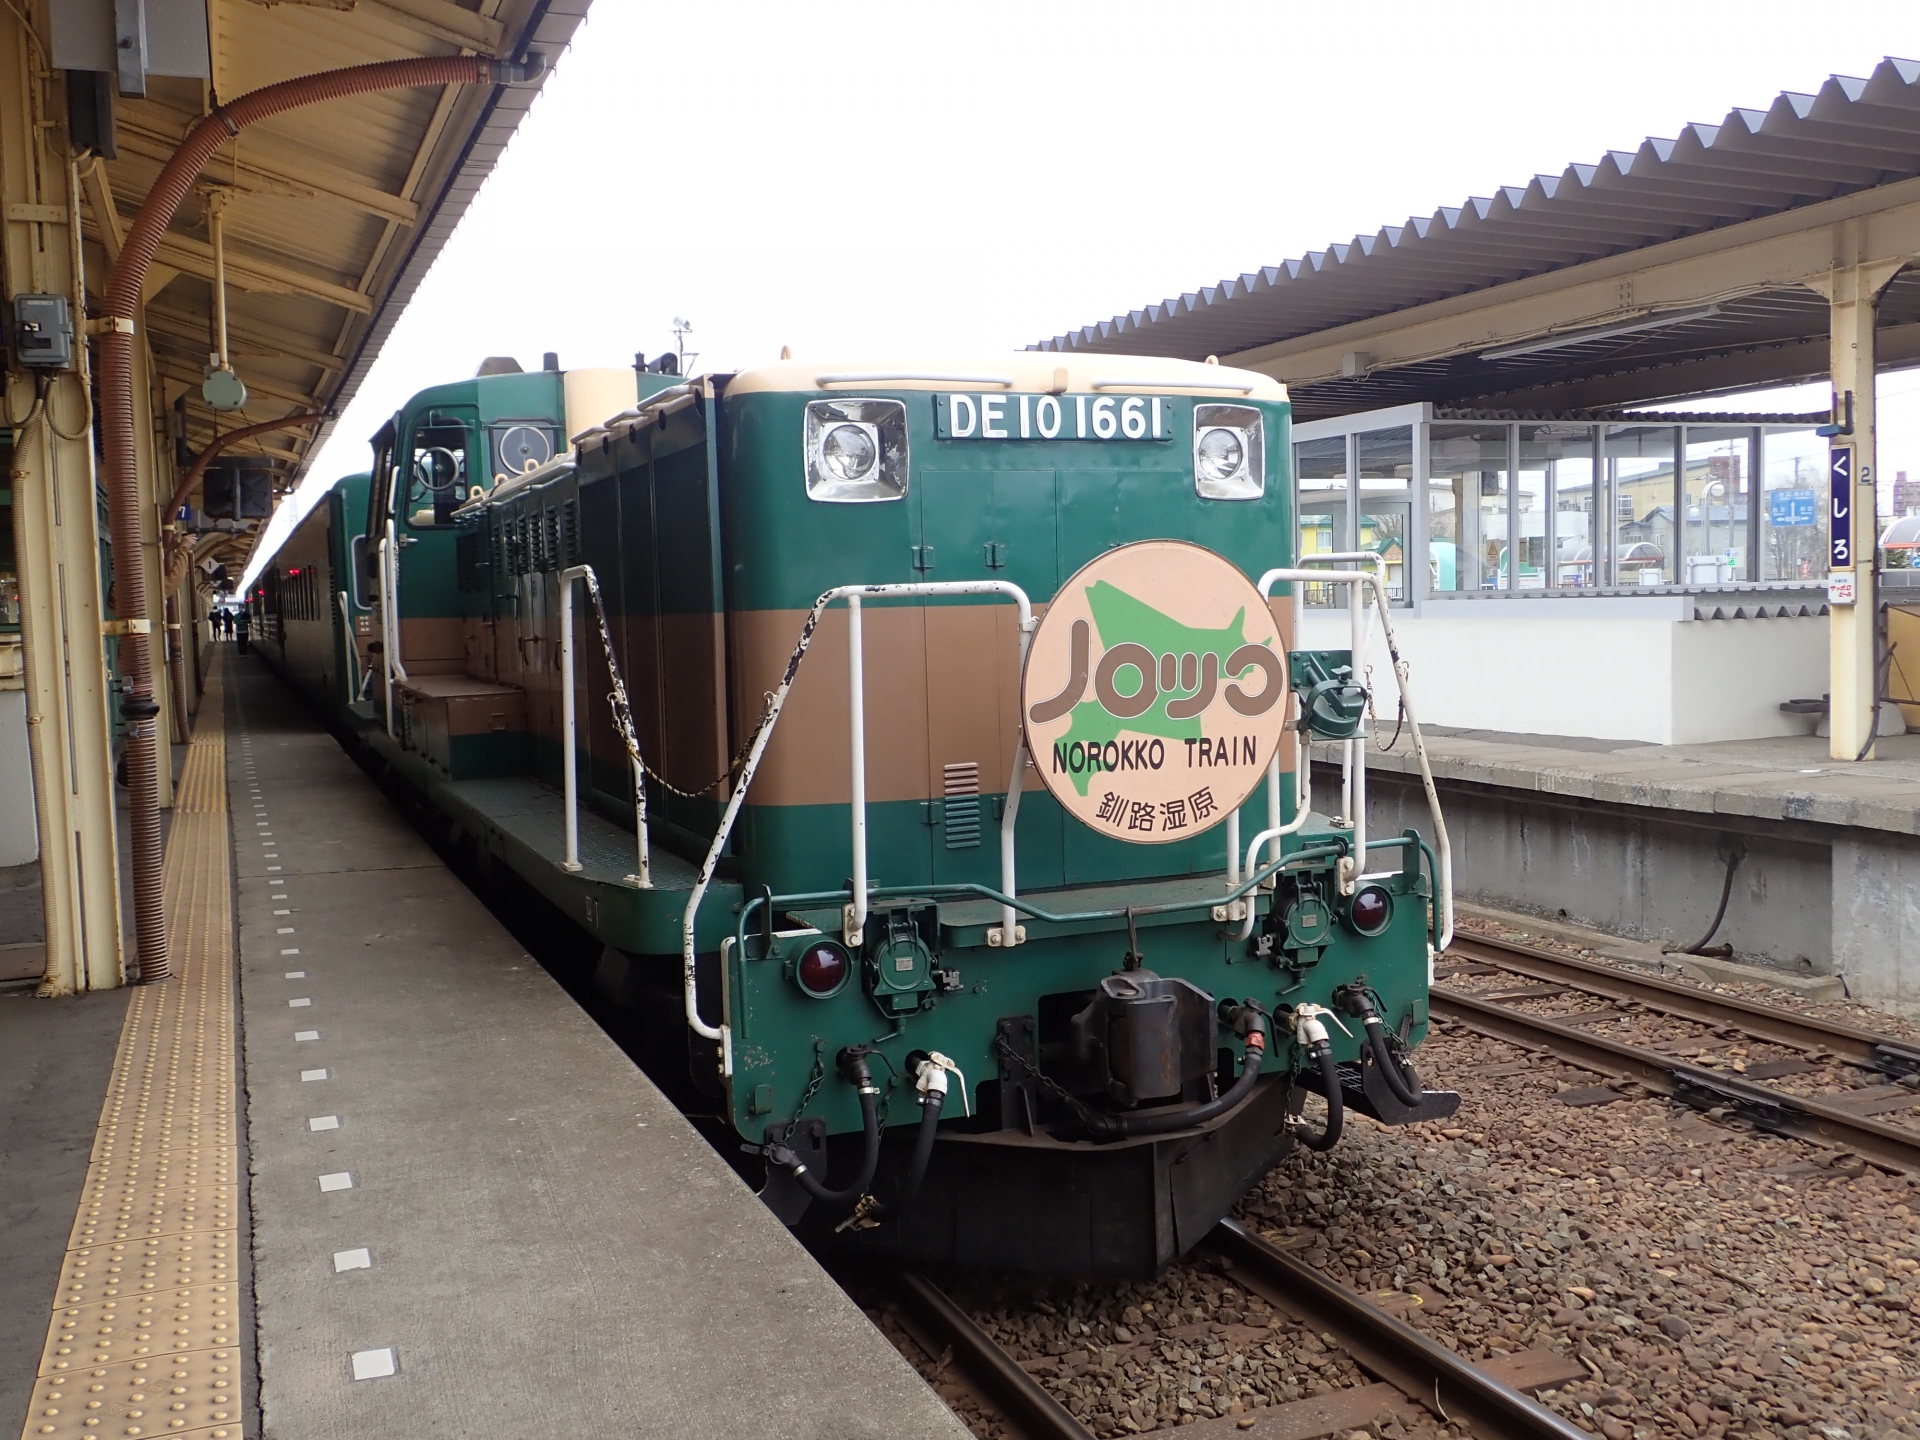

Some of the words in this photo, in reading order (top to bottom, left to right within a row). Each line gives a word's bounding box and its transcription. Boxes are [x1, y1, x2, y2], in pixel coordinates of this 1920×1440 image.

[949, 394, 1008, 438] DE
[1019, 395, 1062, 439] 10
[1075, 396, 1162, 439] 1661
[1860, 466, 1871, 483] 2
[1832, 455, 1849, 560] くしろ
[1052, 738, 1166, 775] NOROKKO
[1183, 735, 1258, 768] TRAIN
[1095, 785, 1219, 832] 釧路湿原
